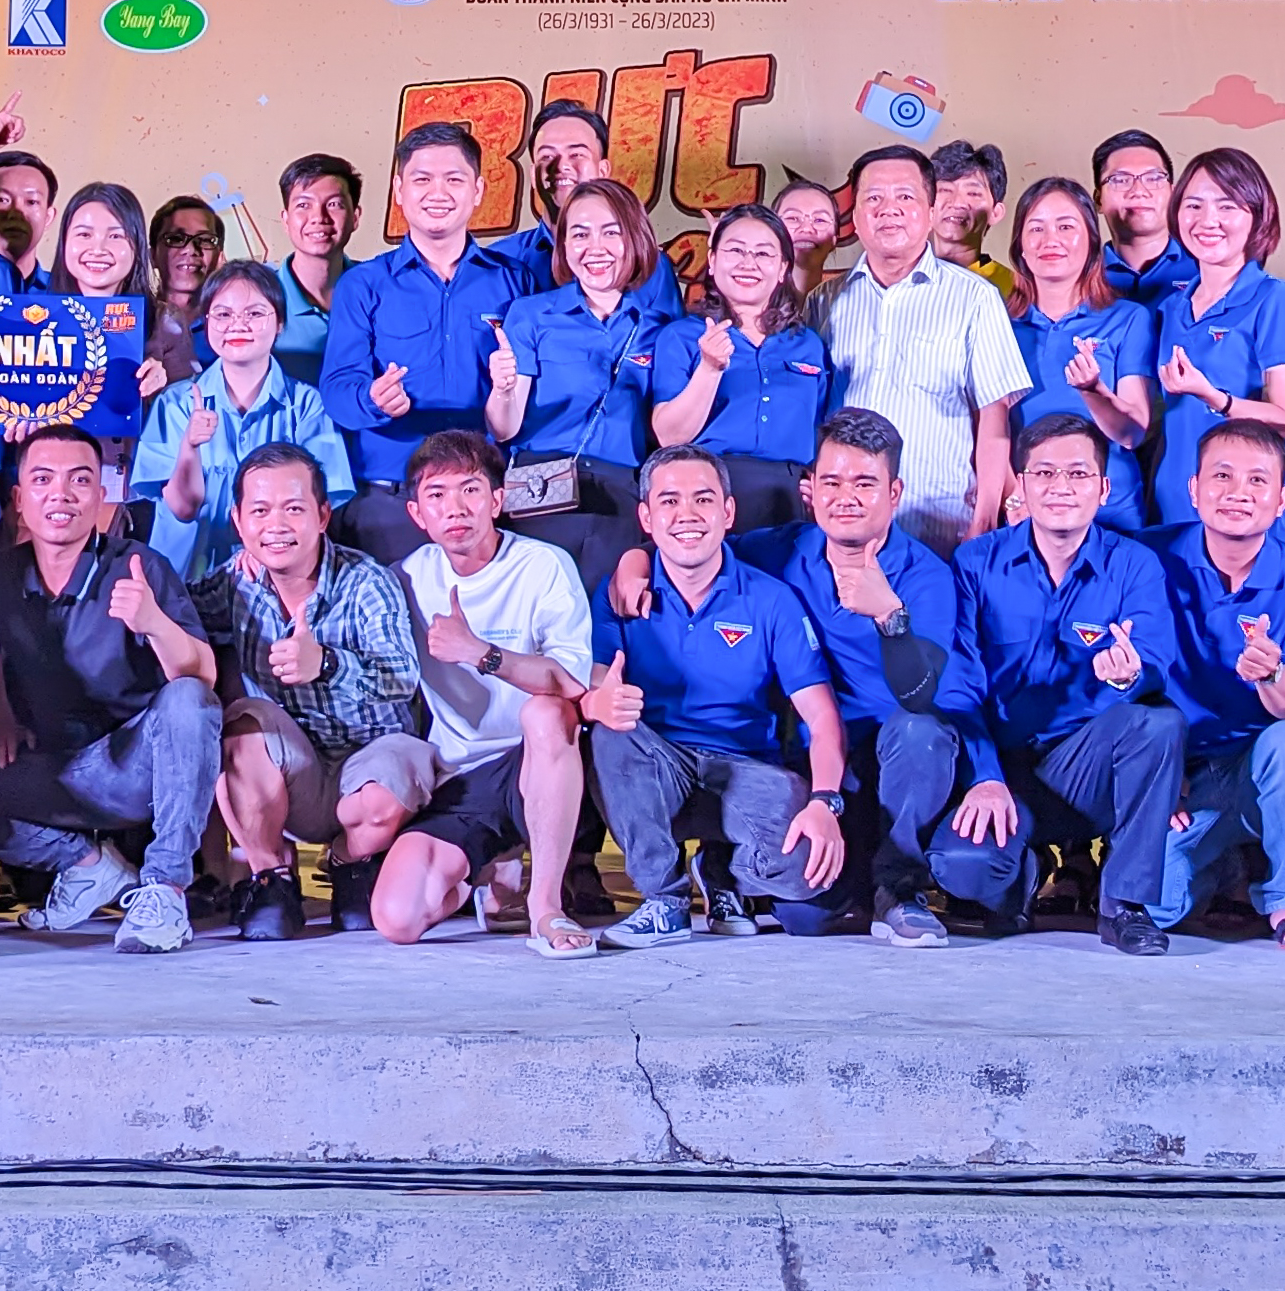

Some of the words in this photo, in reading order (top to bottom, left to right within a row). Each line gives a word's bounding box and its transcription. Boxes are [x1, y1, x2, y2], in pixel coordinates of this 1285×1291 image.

[119, 3, 155, 38] Yang
[158, 3, 191, 38] Bay
[538, 11, 614, 32] (26/3/1931
[631, 11, 715, 32] 26/3/2023)
[7, 48, 66, 56] KHATOCO
[36, 372, 78, 385] ĐOÀN
